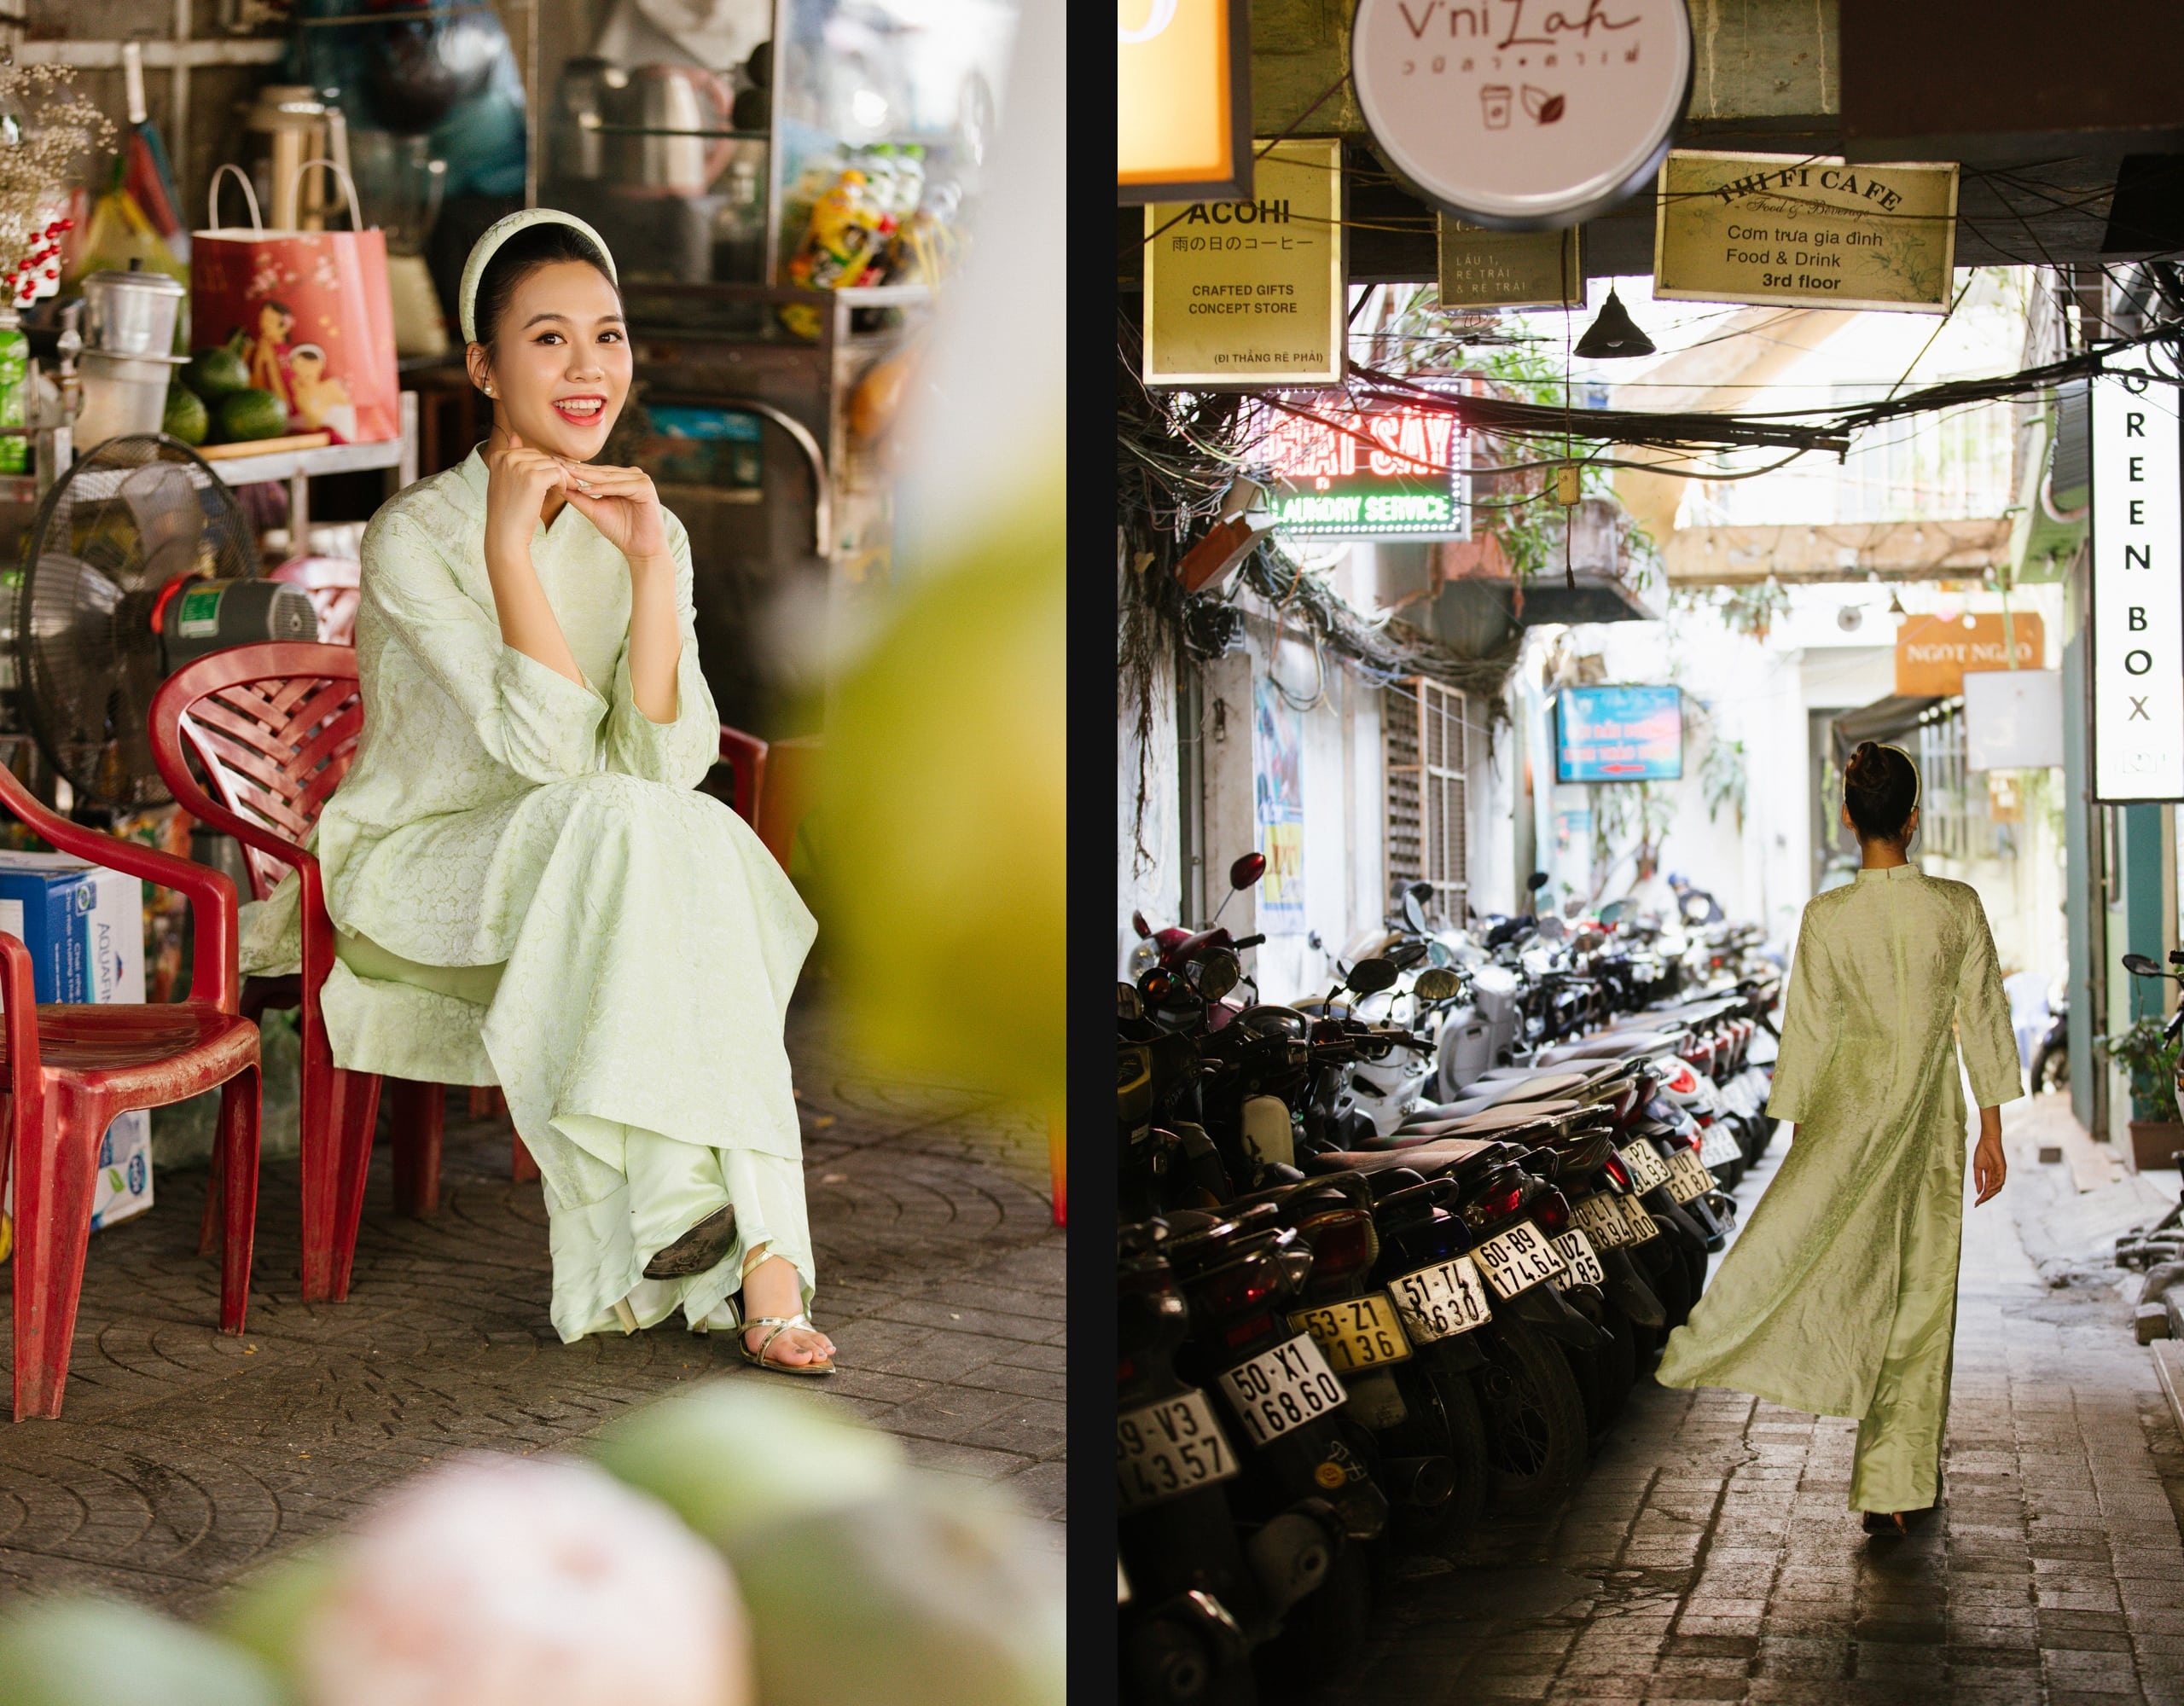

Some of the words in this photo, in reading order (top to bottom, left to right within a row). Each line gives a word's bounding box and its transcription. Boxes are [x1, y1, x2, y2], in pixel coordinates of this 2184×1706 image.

[1714, 172, 1770, 206] THI
[1779, 169, 1809, 188] FI
[1821, 170, 1903, 212] CAFE
[1188, 200, 1290, 224] ACOHI
[1746, 197, 1787, 212] Food
[1172, 235, 1314, 252] 雨の日のコーヒー
[1728, 224, 1769, 241] Cơm
[1774, 227, 1809, 243] trưa
[1814, 229, 1840, 247] gia
[1845, 230, 1884, 247] đình
[1726, 248, 1770, 264] Food
[1776, 251, 1788, 265] &
[1795, 252, 1841, 268] Drink
[1192, 285, 1252, 296] CRAFTED
[1256, 284, 1294, 296] GIFTS
[1456, 284, 1464, 293] &
[1763, 273, 1792, 287] 3rd
[1798, 274, 1842, 290] floor
[1188, 303, 1251, 314] CONCEPT
[1254, 303, 1298, 314] STORE
[1214, 353, 1229, 365] (ĐI
[2123, 368, 2151, 570] GREEN
[1271, 496, 1362, 524] LAUNDRY
[1364, 494, 1449, 522] SERVICE
[2124, 606, 2152, 721] BOX
[1480, 1227, 1536, 1268] 60-B9
[1492, 1248, 1561, 1295] 174.64
[1304, 1301, 1380, 1340] 53-Z1
[1231, 1343, 1310, 1401] 50-X1
[1243, 1372, 1339, 1440] 168.60
